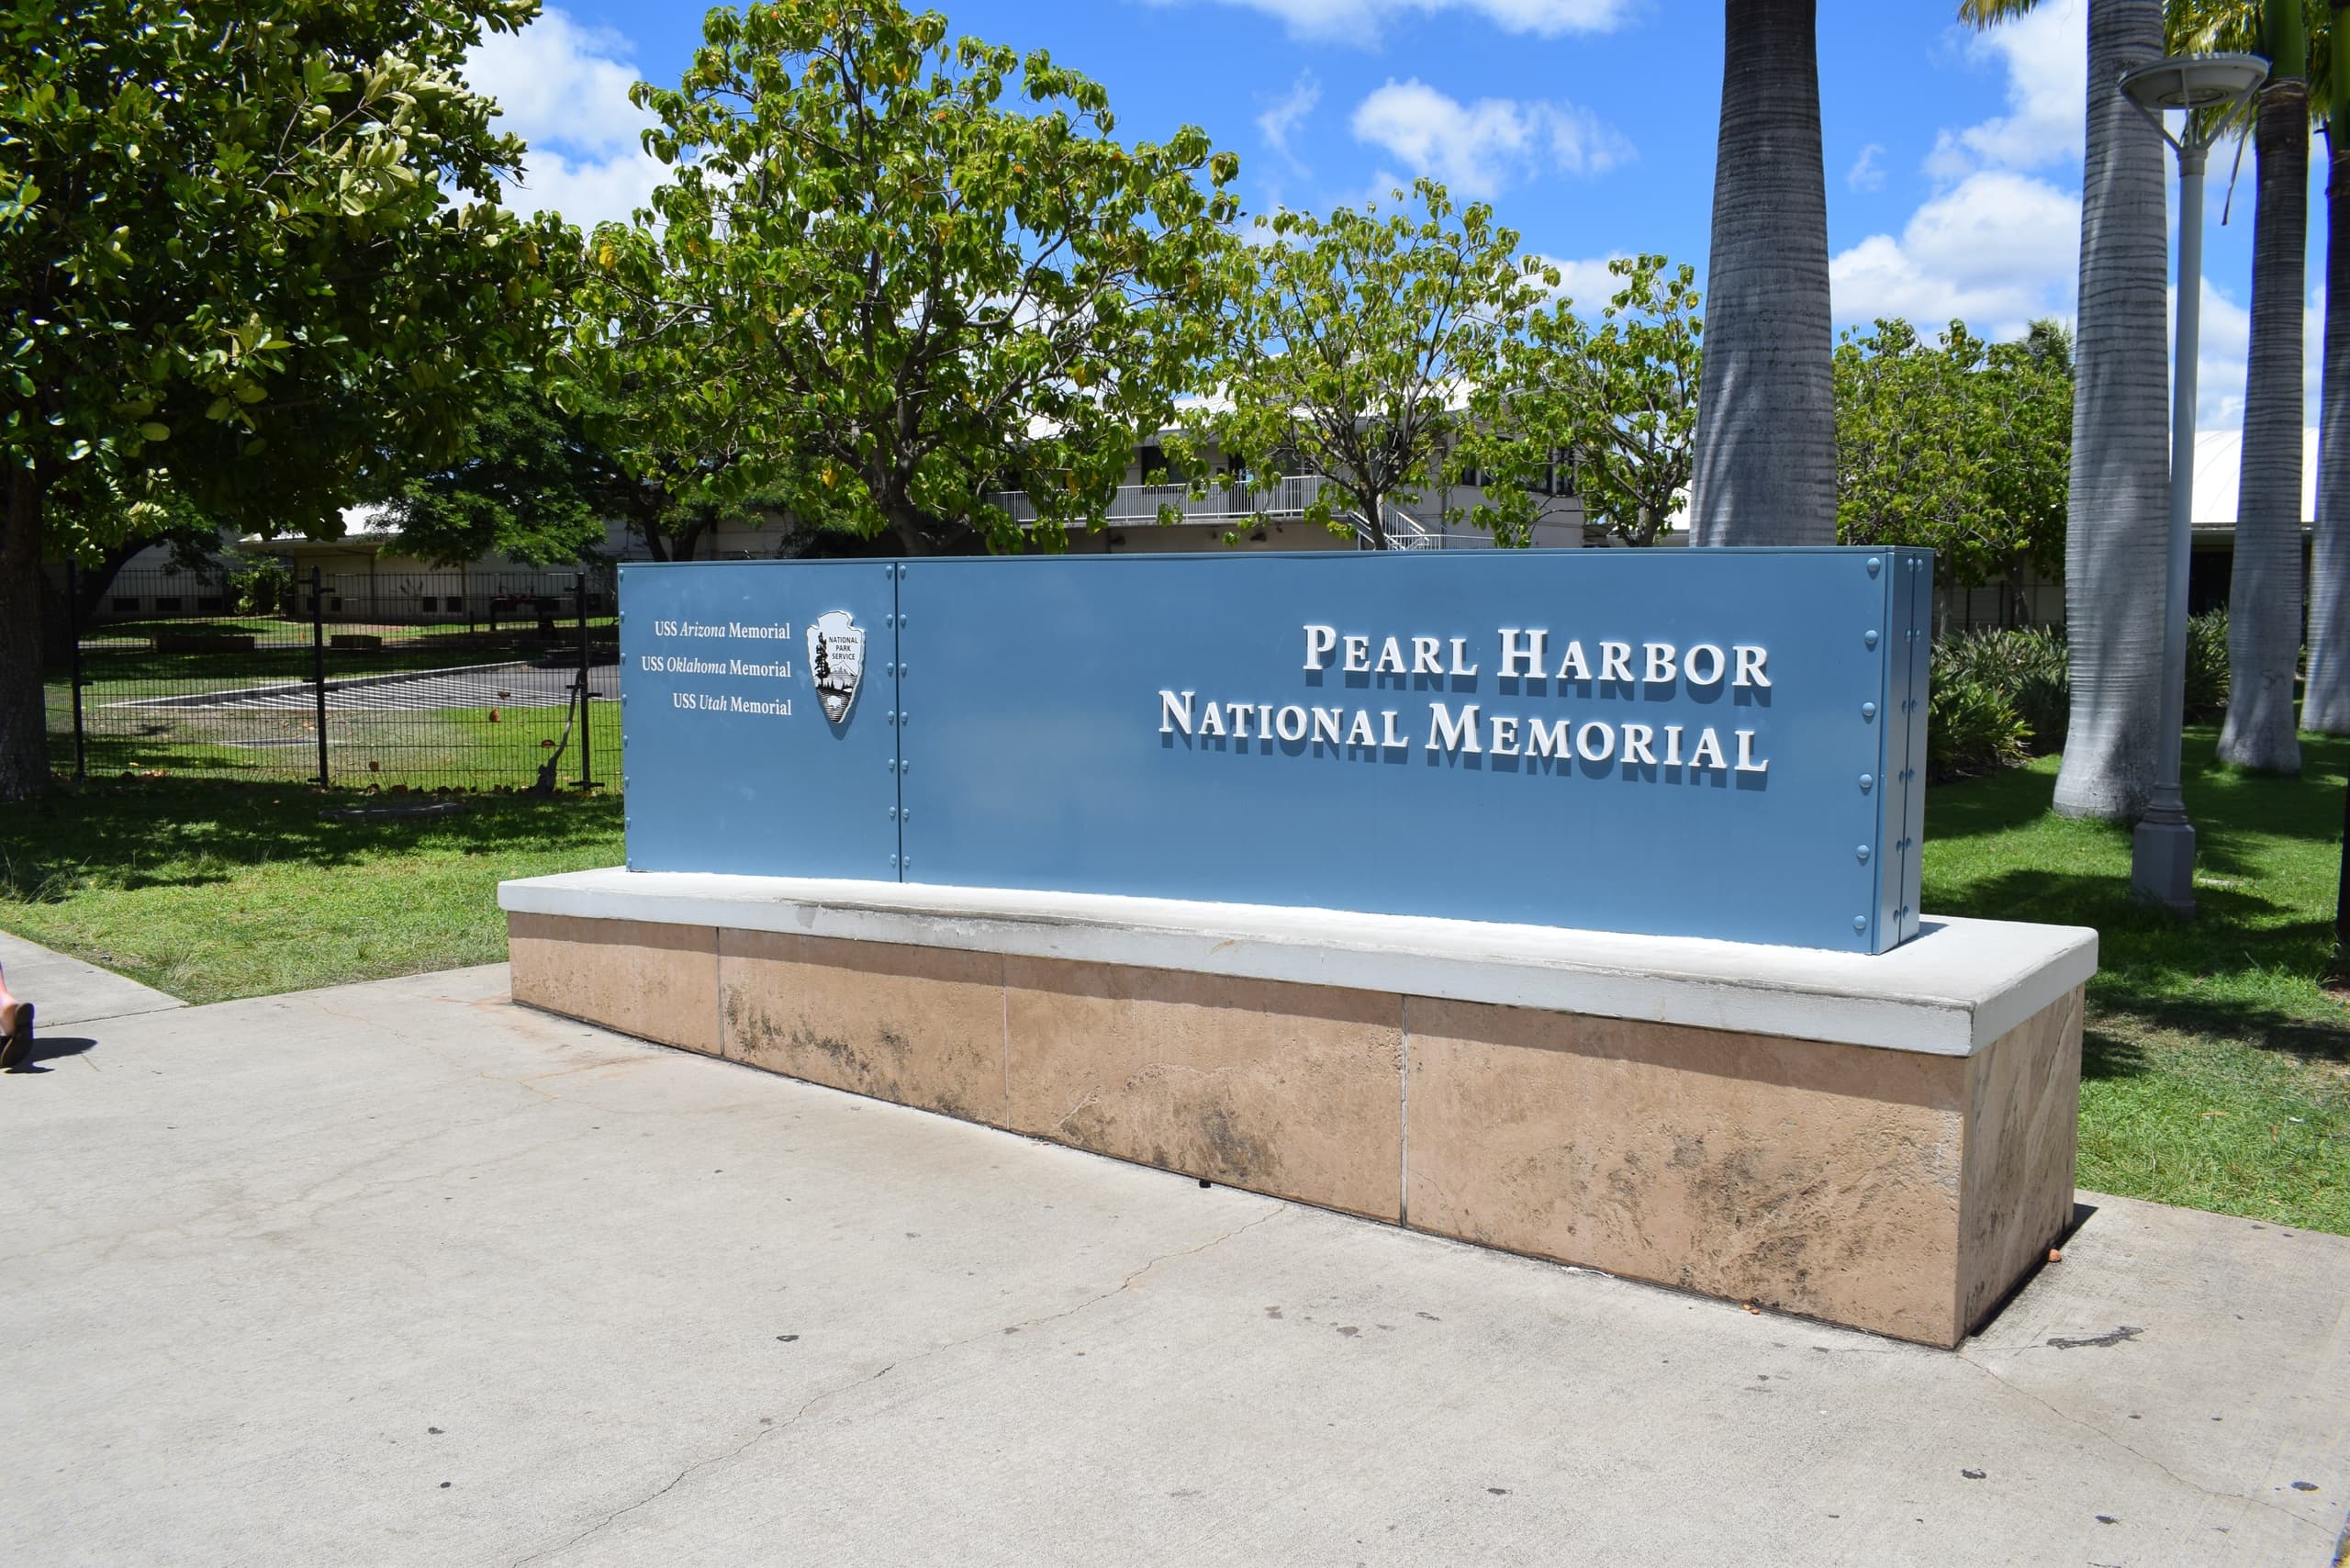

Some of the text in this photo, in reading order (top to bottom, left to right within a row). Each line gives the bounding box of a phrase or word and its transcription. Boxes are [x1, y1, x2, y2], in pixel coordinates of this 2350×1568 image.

[655, 621, 790, 639] USS Arizona Memorial
[642, 655, 791, 678] USS Oklahoma Memorial
[832, 653, 856, 661] SERVICE
[1303, 625, 1772, 688] PEARL HARBOR
[673, 693, 792, 716] USS Utah Memorial
[1158, 690, 1769, 772] NATIONAL MEMORIAL
